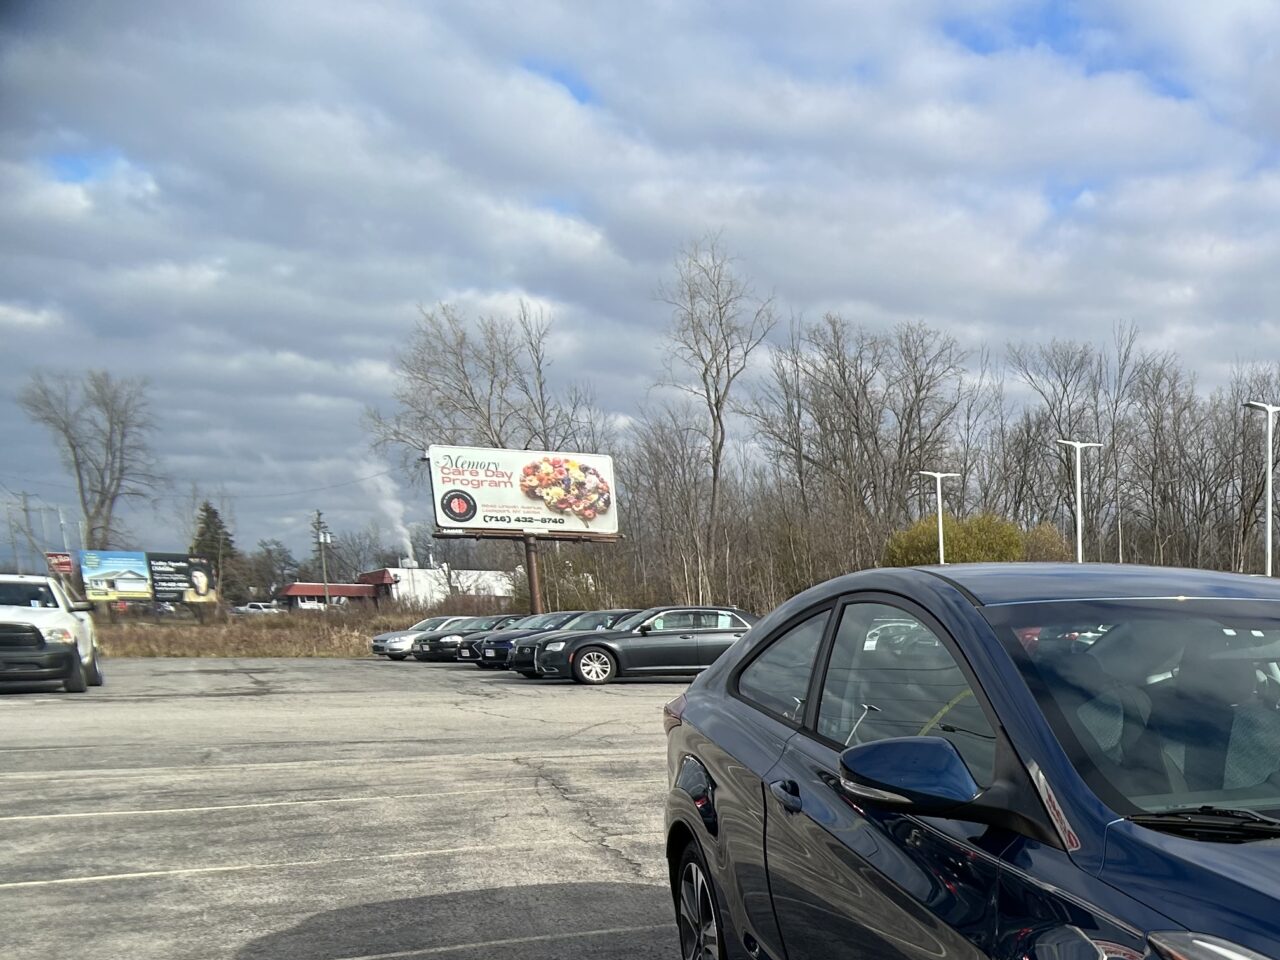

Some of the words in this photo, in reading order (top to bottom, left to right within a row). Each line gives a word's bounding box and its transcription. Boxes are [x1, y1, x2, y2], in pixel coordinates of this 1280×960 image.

[435, 454, 500, 471] Memory
[440, 466, 480, 477] Care
[484, 469, 514, 480] Day
[441, 476, 514, 489] Program
[483, 515, 511, 524] (716)
[514, 516, 565, 525] 432-8740
